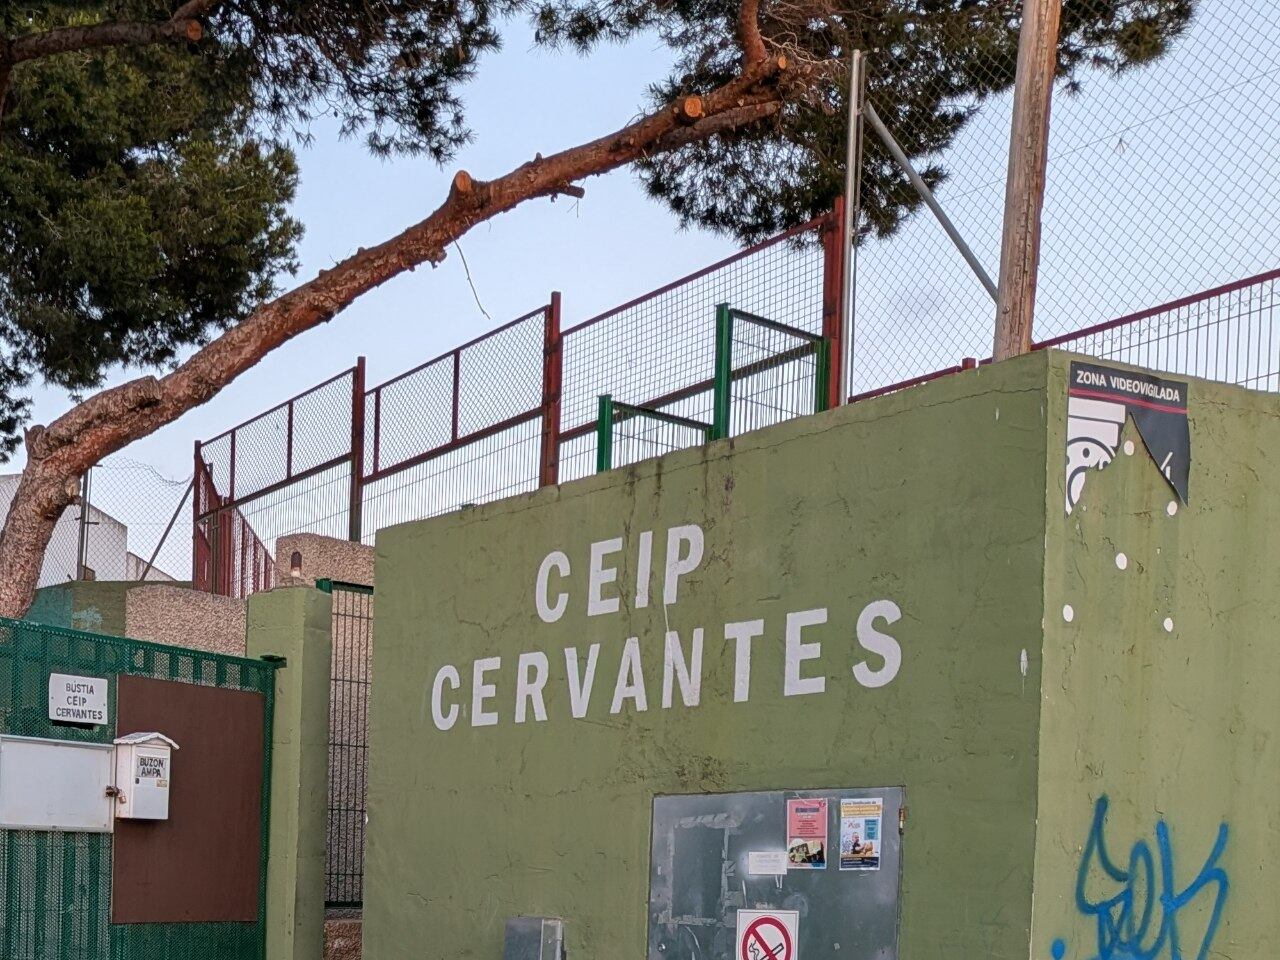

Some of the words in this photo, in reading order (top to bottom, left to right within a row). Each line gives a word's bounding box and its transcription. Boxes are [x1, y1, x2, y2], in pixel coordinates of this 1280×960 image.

[1076, 370, 1107, 388] ZONA
[1109, 375, 1180, 402] VIDEOVIGILADA
[535, 524, 704, 623] CEIP
[431, 600, 903, 730] CERVANTES
[66, 695, 87, 707] CEIP
[55, 707, 103, 720] CERVANTES
[140, 768, 162, 778] AMPA
